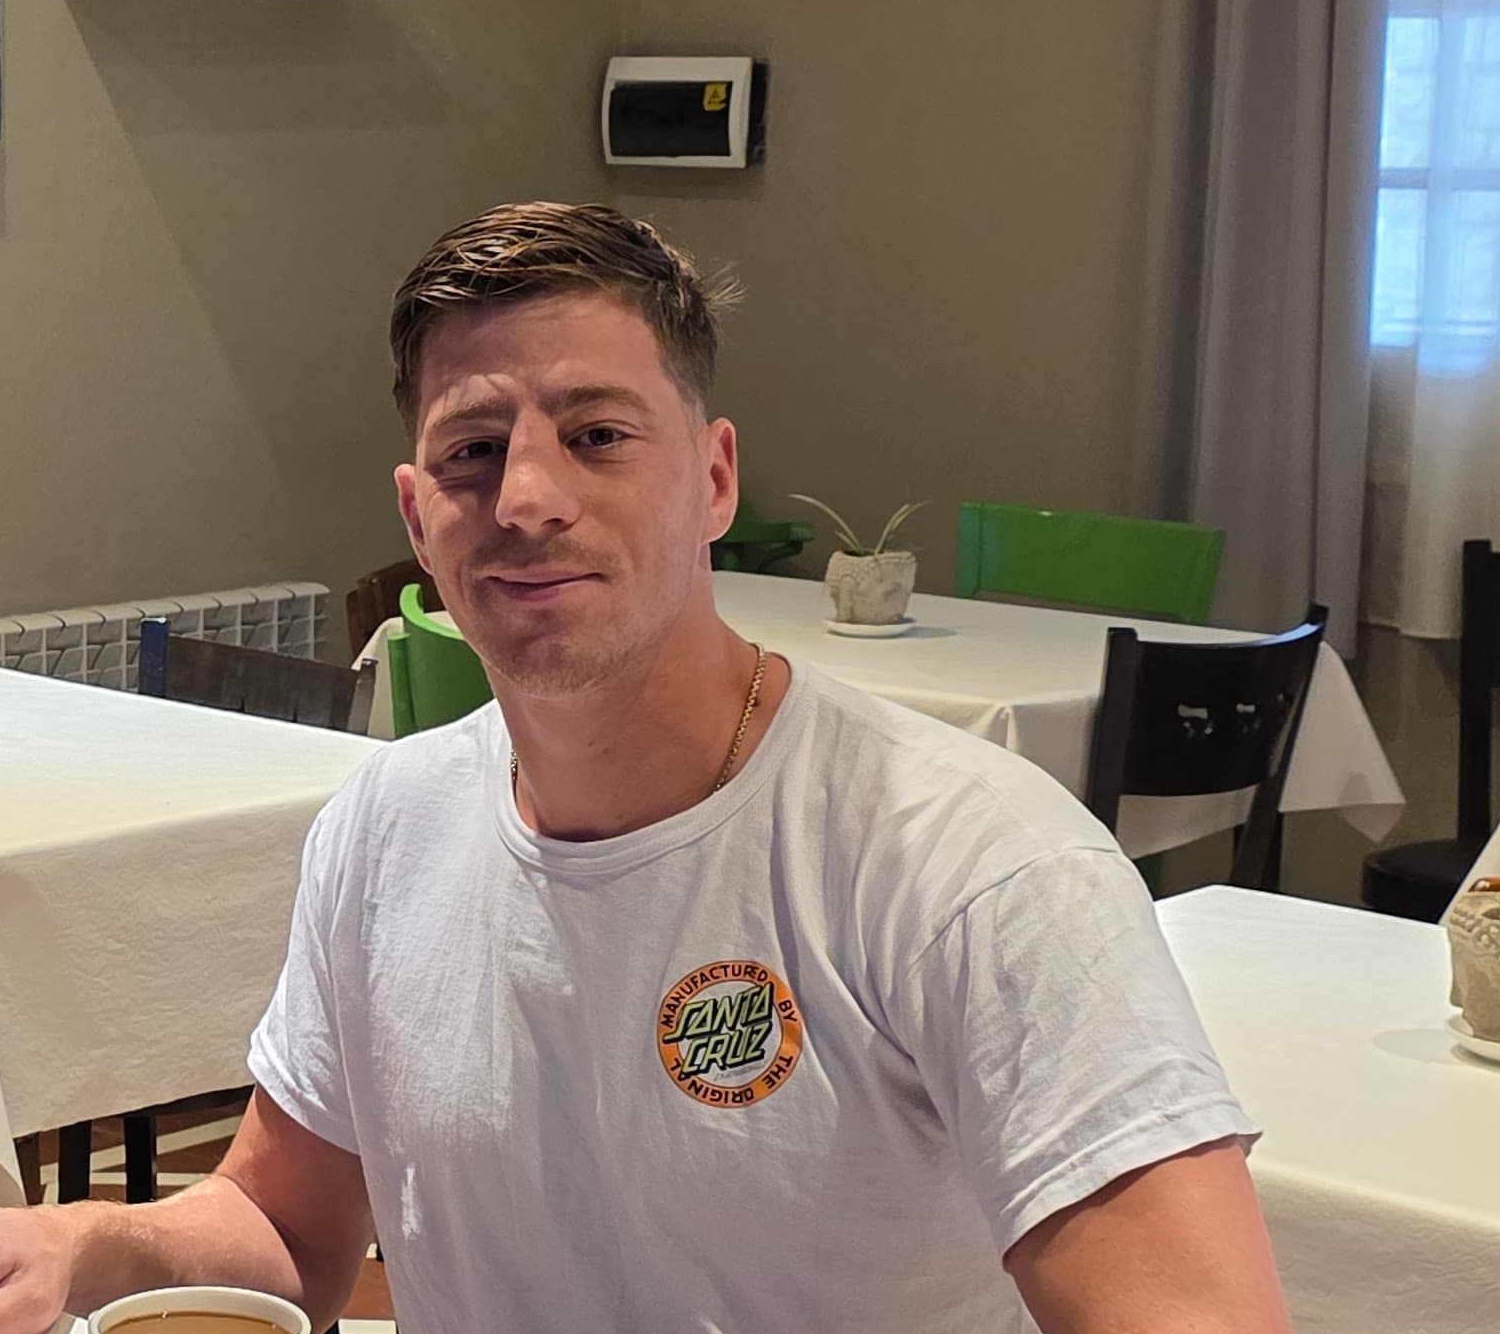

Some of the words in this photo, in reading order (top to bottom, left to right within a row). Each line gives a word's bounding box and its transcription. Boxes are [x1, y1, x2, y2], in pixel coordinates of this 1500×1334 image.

[661, 964, 768, 1028] MANUFACTURED
[662, 982, 774, 1044] SANTA
[779, 999, 797, 1022] BY
[682, 1023, 773, 1076] CRUZ
[764, 1055, 793, 1089] THE
[669, 1058, 754, 1103] ORIGINAL
